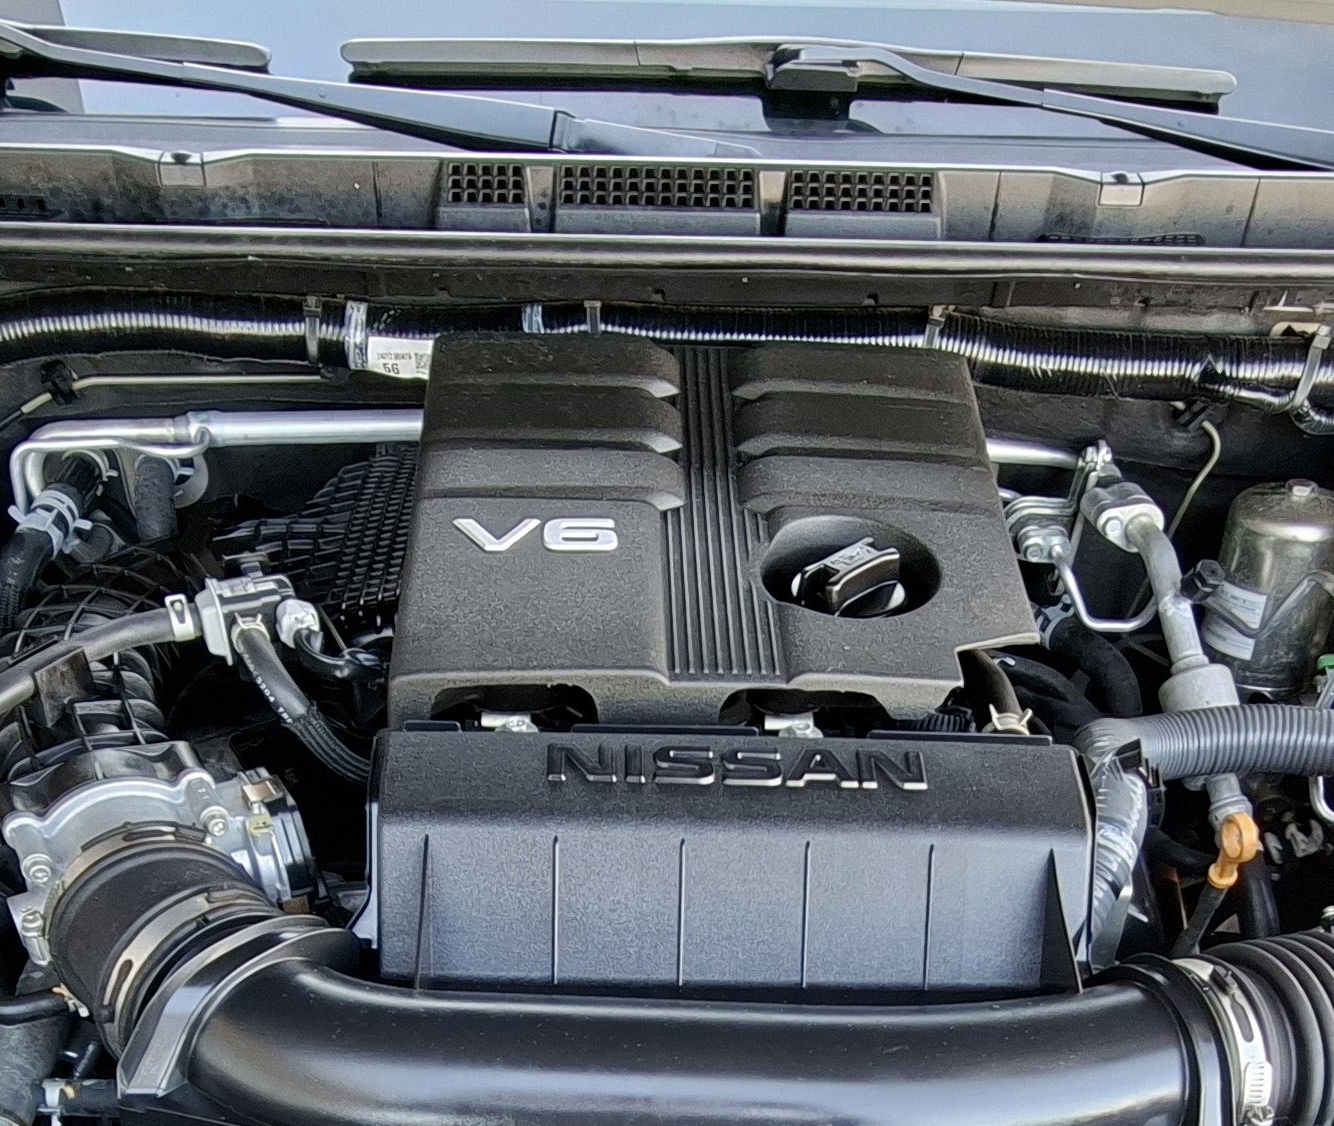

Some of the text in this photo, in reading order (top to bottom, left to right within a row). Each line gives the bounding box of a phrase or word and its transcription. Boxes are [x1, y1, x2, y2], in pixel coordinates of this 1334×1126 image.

[382, 362, 400, 375] 56
[451, 517, 618, 552] V6
[545, 742, 929, 791] NISSAN
